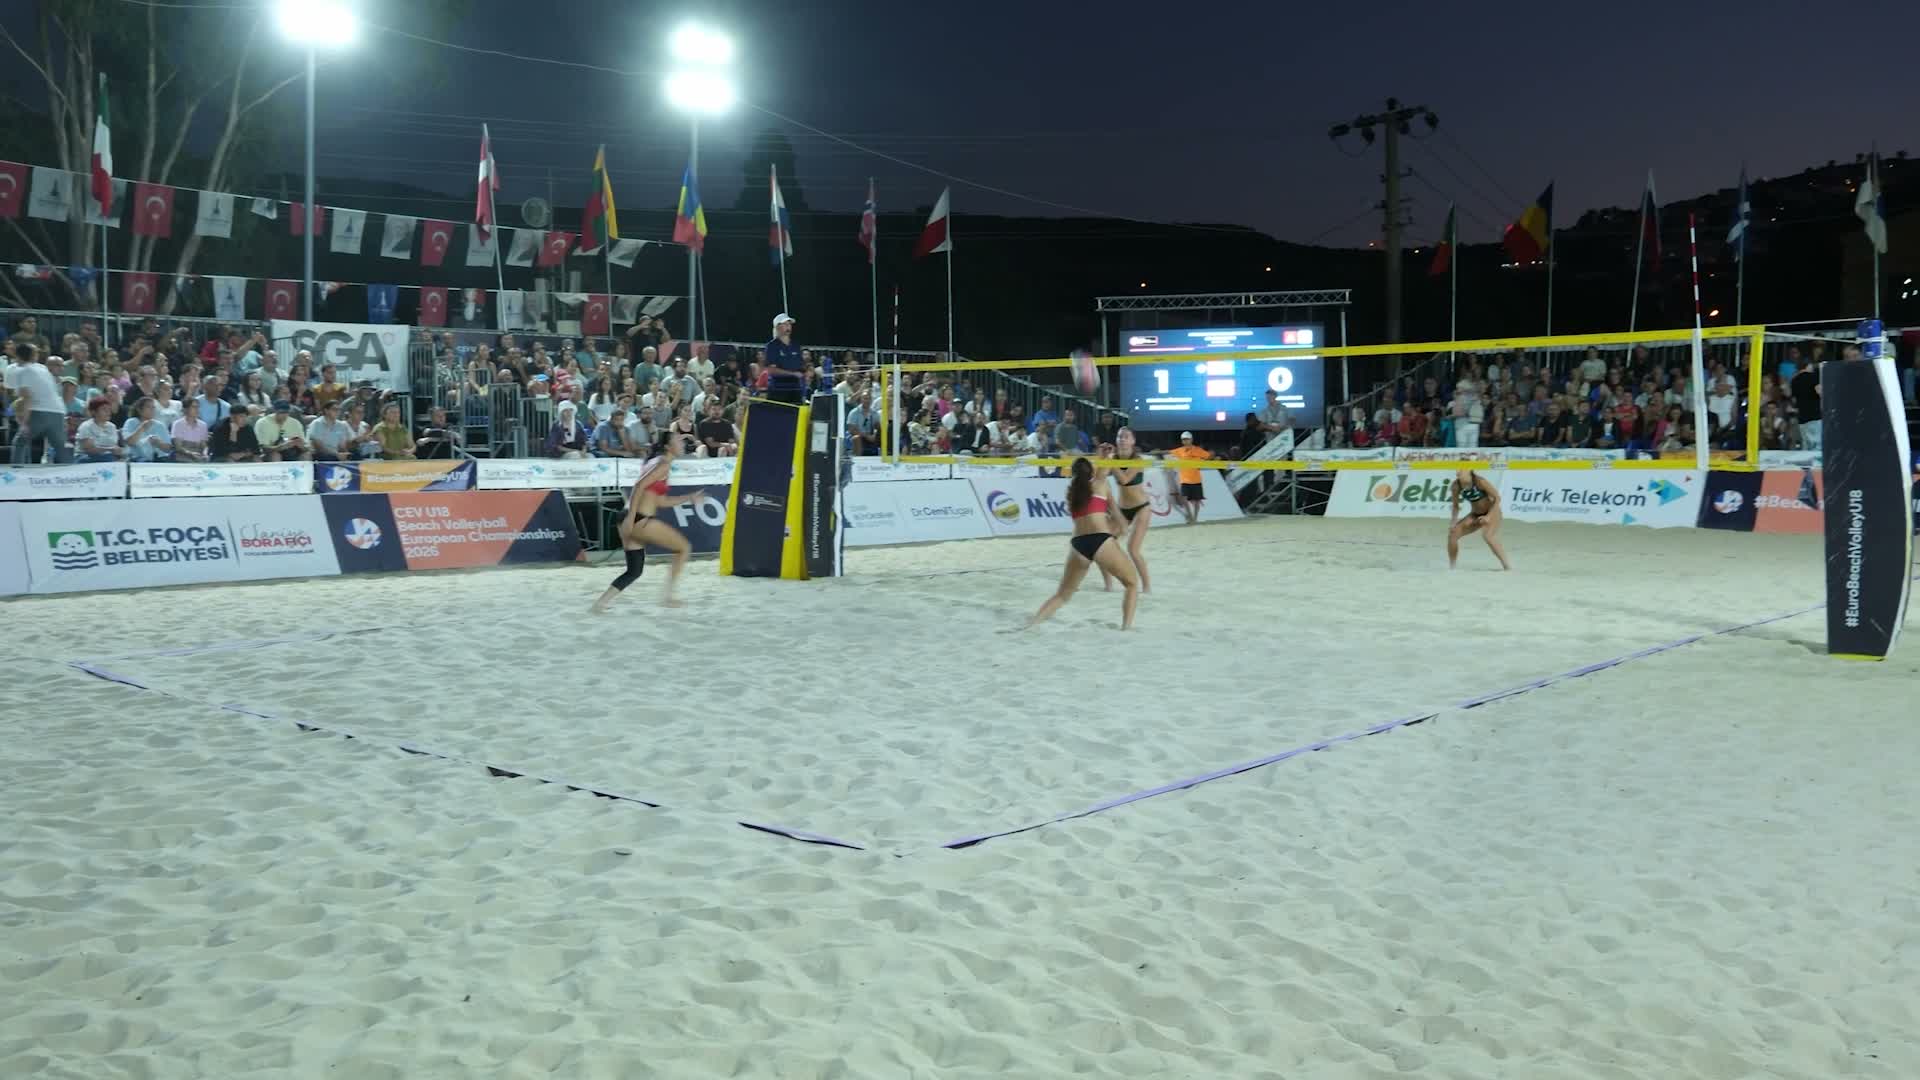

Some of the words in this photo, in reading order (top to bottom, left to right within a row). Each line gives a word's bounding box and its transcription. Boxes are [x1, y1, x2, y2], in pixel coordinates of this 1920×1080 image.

[292, 329, 391, 371] SGA
[1154, 369, 1169, 393] 1
[1268, 366, 1293, 392] 0
[1512, 487, 1553, 503] Türk
[1562, 489, 1646, 507] Telekom
[394, 506, 422, 518] CEV
[428, 506, 449, 517] U18
[673, 496, 730, 527] FO
[96, 528, 144, 547] T.C.
[148, 526, 225, 546] FOÇA
[398, 520, 440, 531] Beach
[445, 517, 506, 534] Volleyball
[401, 533, 466, 547] European
[468, 528, 566, 543] Championships
[103, 542, 229, 566] BELEDİYESİ
[406, 546, 440, 559] 2026
[1846, 490, 1865, 627] #EuroBeachVolleyU18
